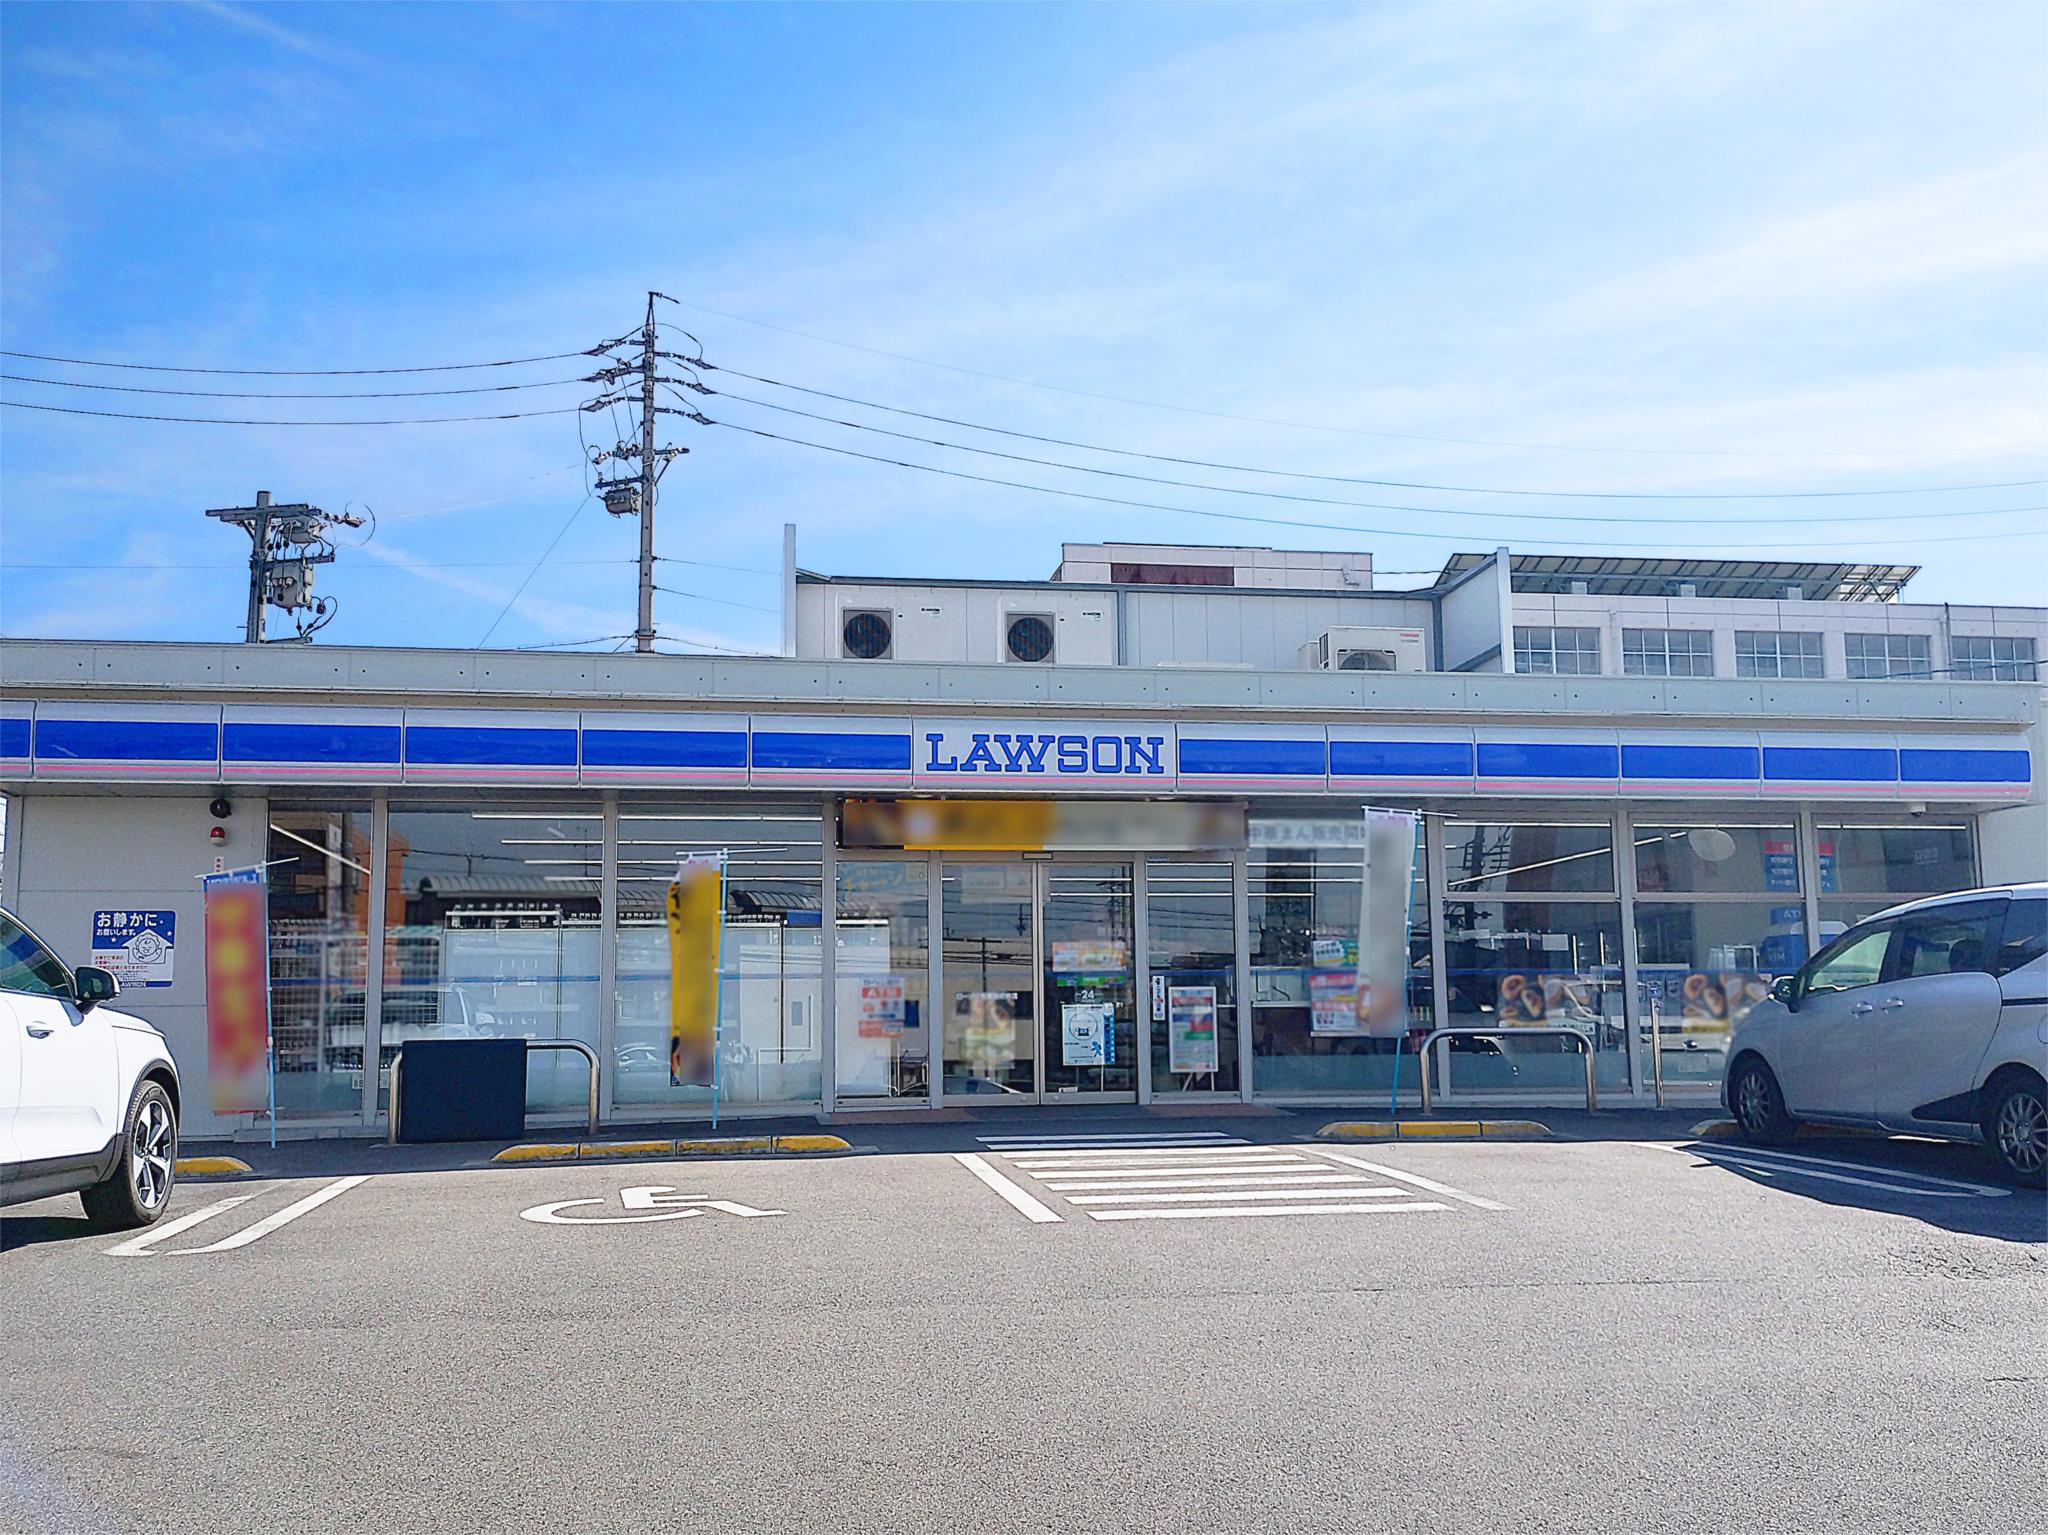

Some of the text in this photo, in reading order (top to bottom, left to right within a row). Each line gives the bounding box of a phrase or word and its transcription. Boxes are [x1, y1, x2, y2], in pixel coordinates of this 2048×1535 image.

[926, 733, 1164, 773] LAWSON
[97, 912, 157, 927] お静かに
[96, 928, 136, 936] お願いします。
[1081, 990, 1094, 999] 24
